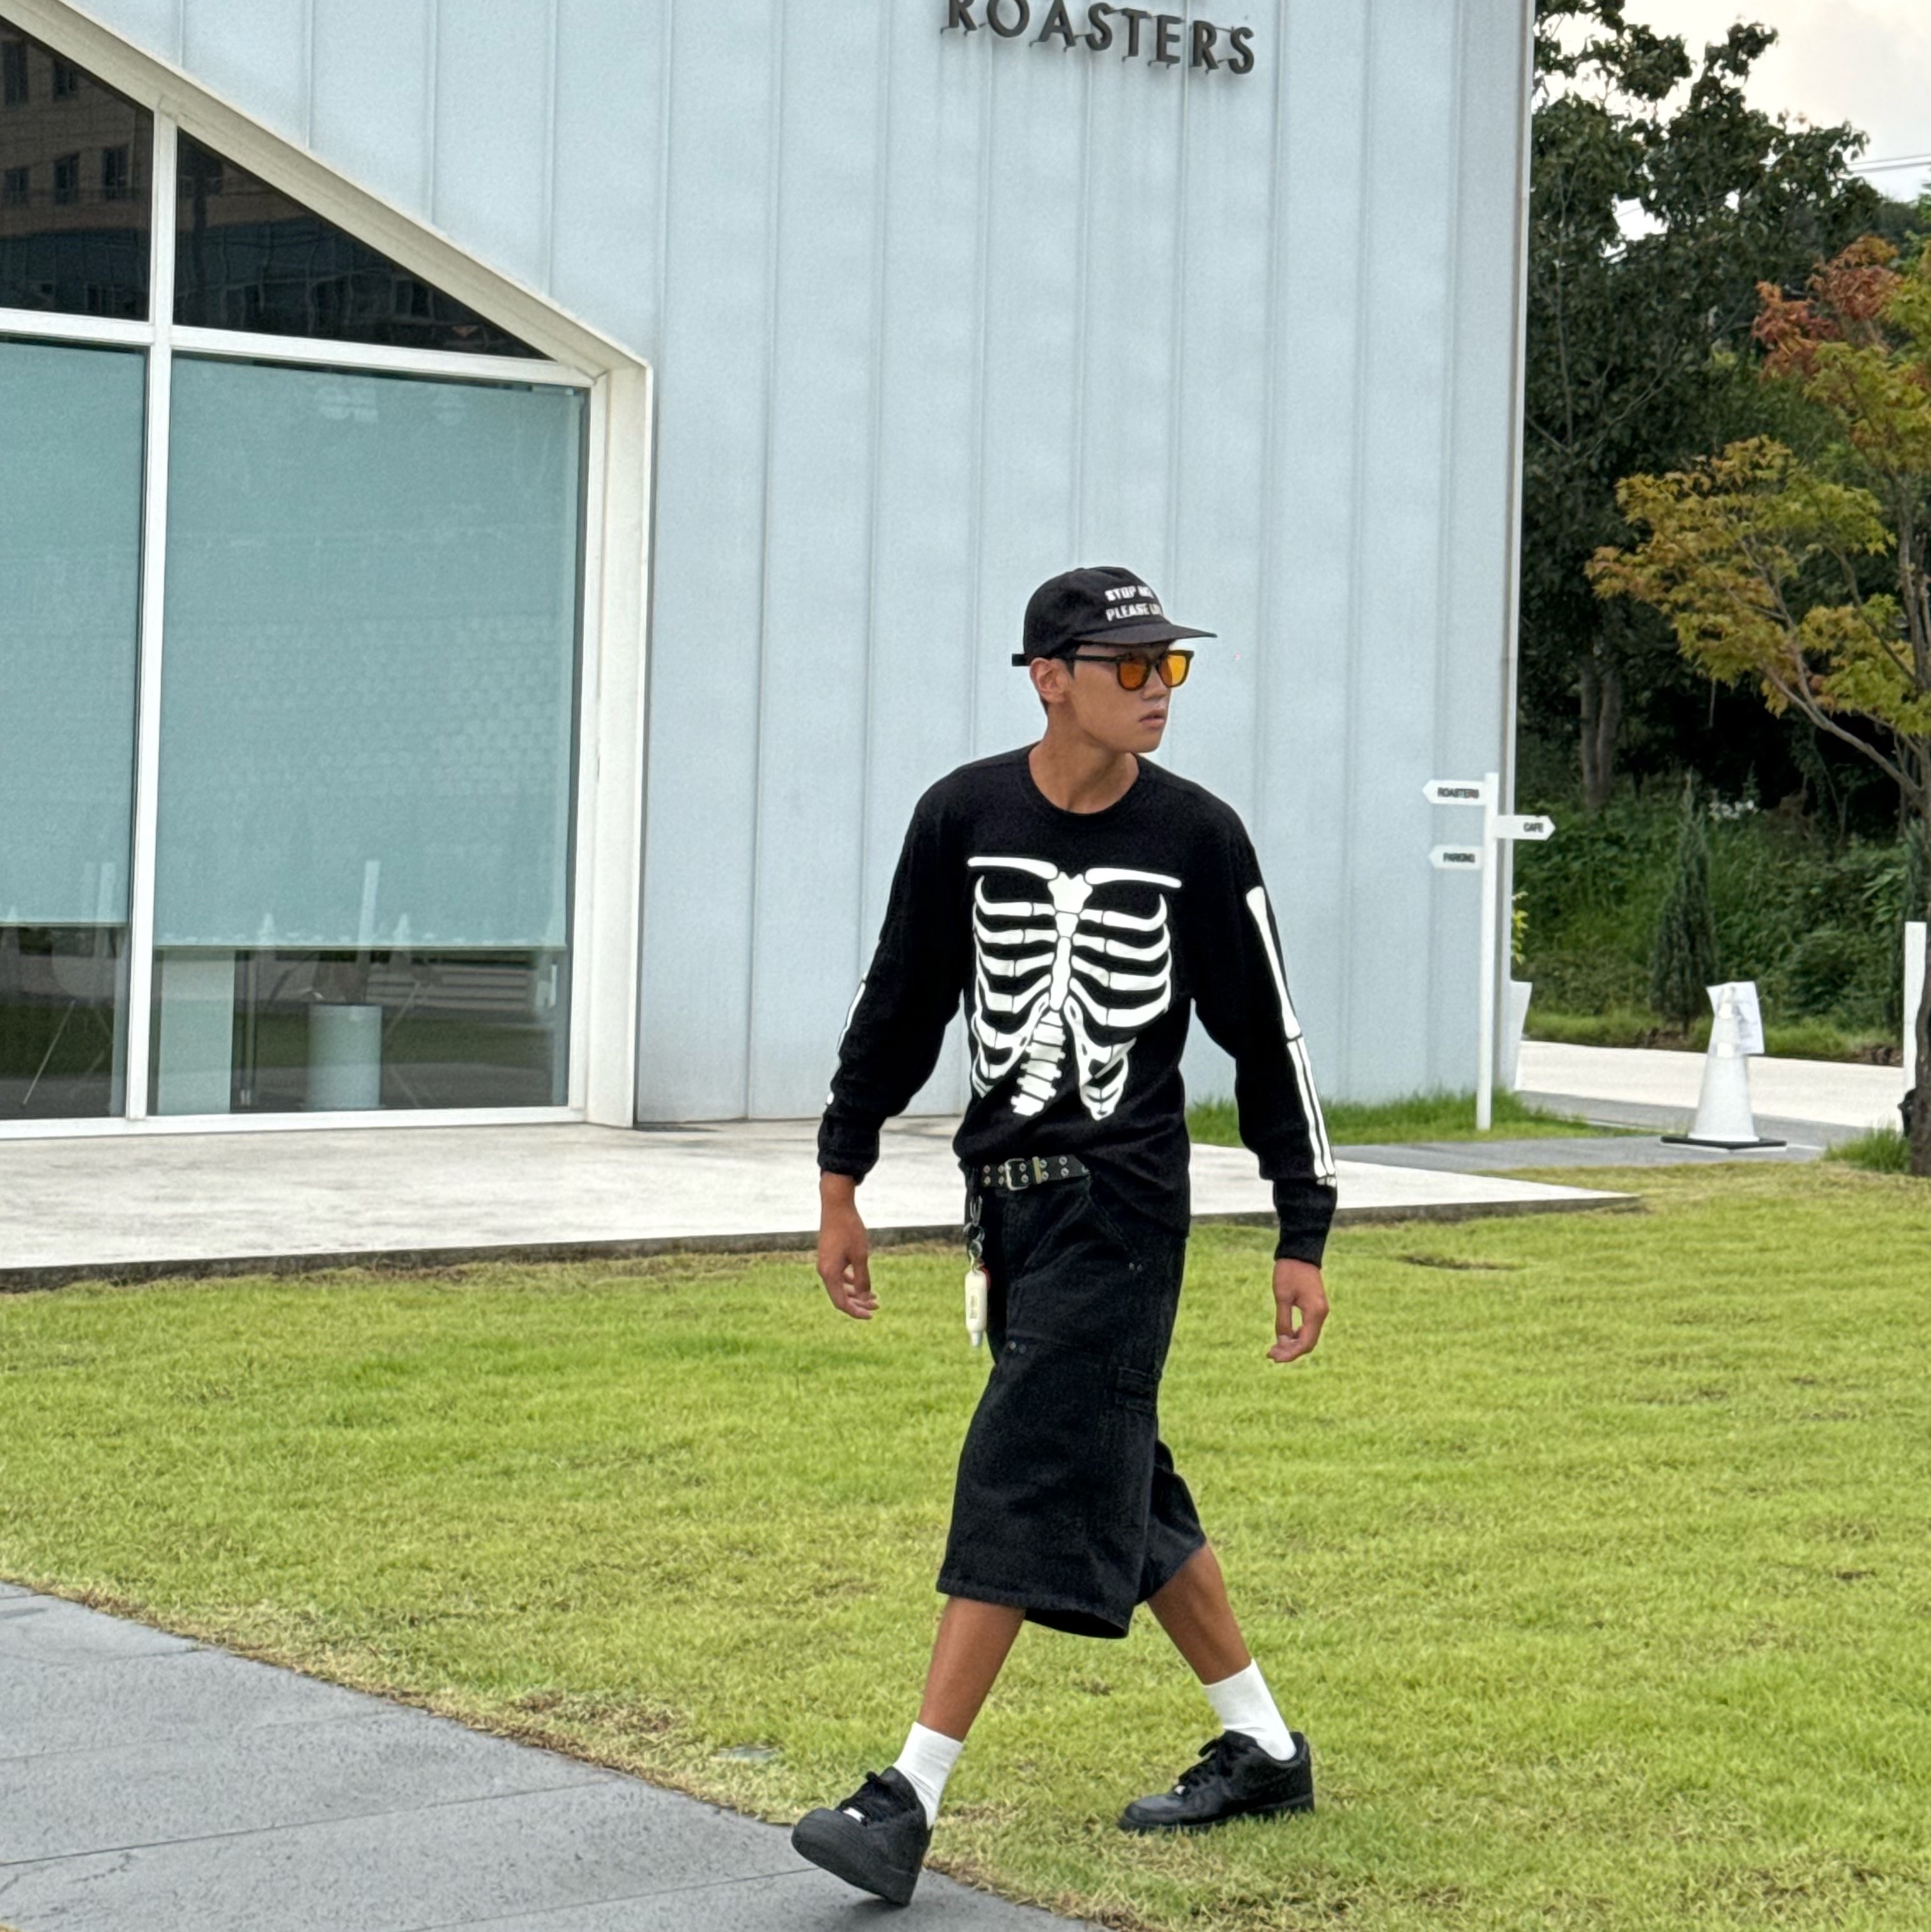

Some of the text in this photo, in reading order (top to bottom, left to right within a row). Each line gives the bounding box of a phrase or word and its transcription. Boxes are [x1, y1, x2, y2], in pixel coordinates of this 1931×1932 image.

[948, 0, 1254, 75] ROASTERS
[1106, 602, 1150, 621] PLEASE
[1523, 822, 1544, 833] CAFE
